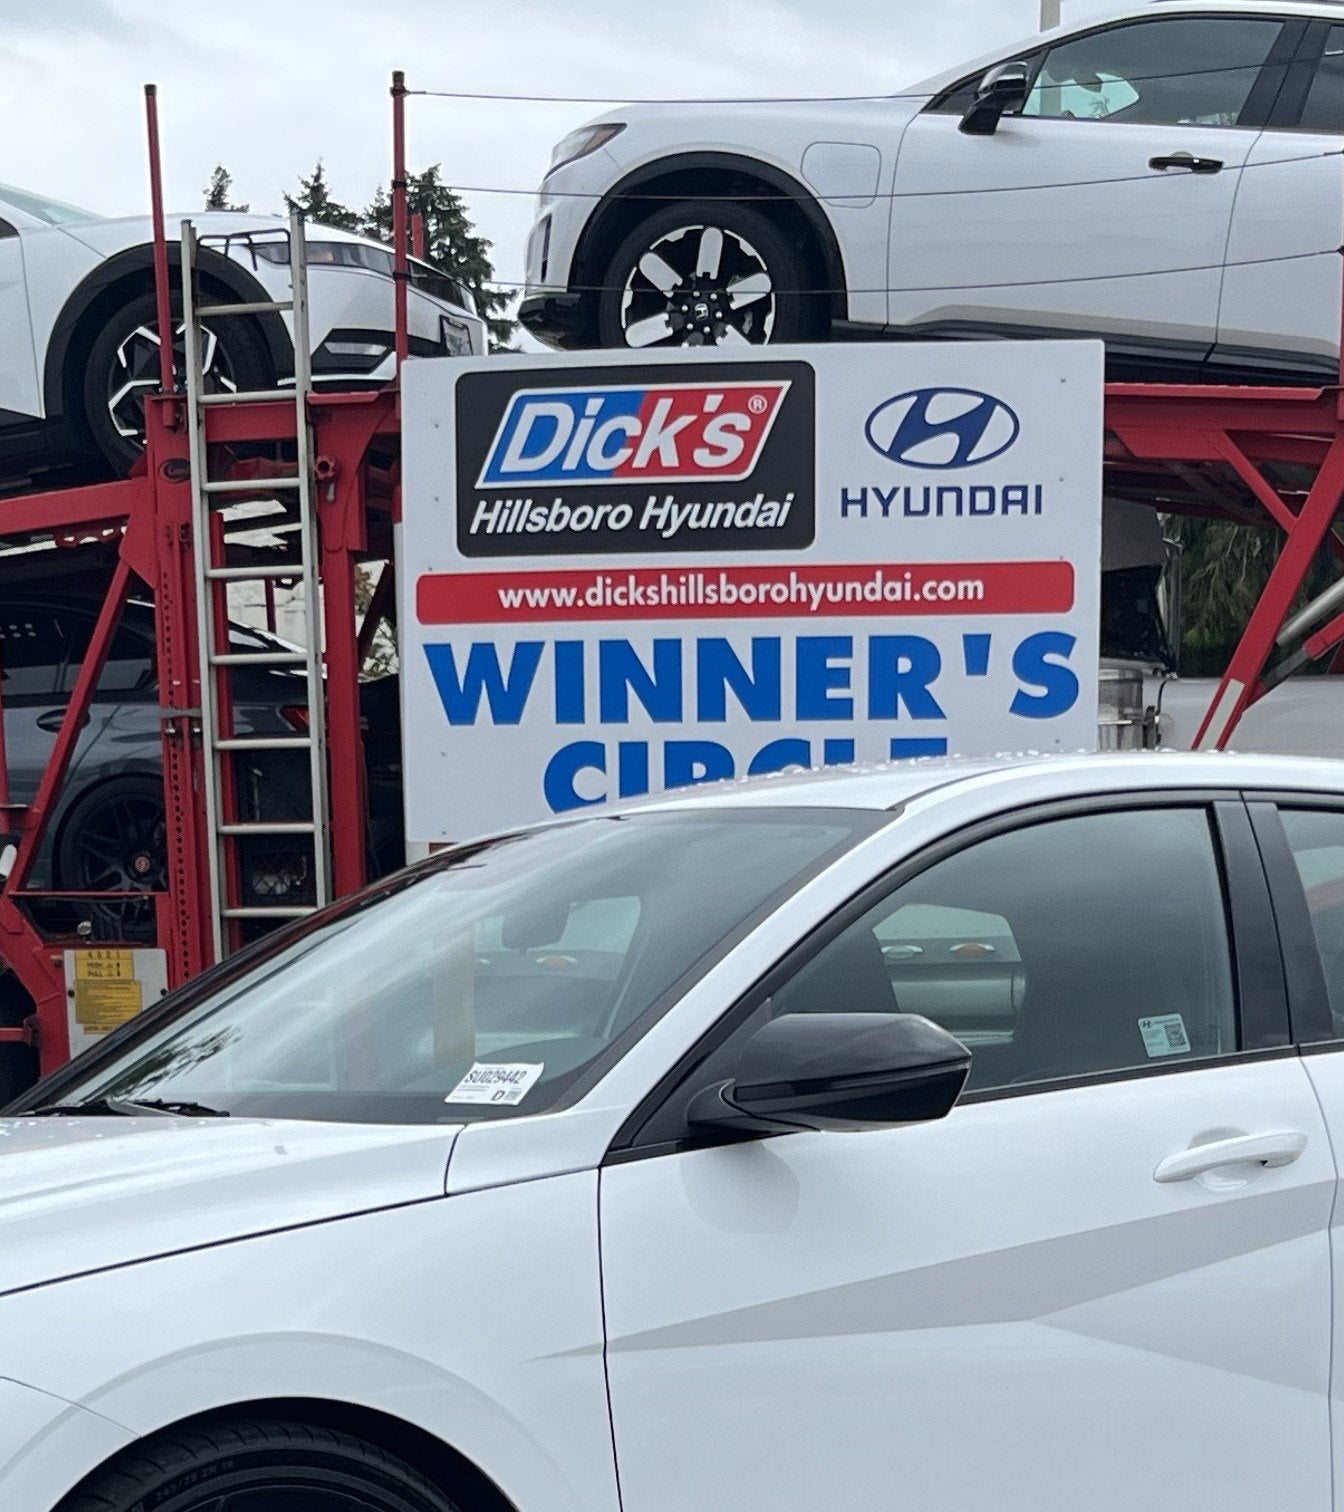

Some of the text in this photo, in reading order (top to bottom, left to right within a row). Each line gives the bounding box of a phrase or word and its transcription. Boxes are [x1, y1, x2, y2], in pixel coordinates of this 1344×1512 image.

[499, 394, 752, 473] Dick's
[469, 493, 793, 538] Hillsboro Hyundai
[841, 485, 1043, 518] HYUNDAI
[498, 572, 985, 611] www.dickshillsborohyundai.com
[422, 631, 1081, 726] WINNER'S
